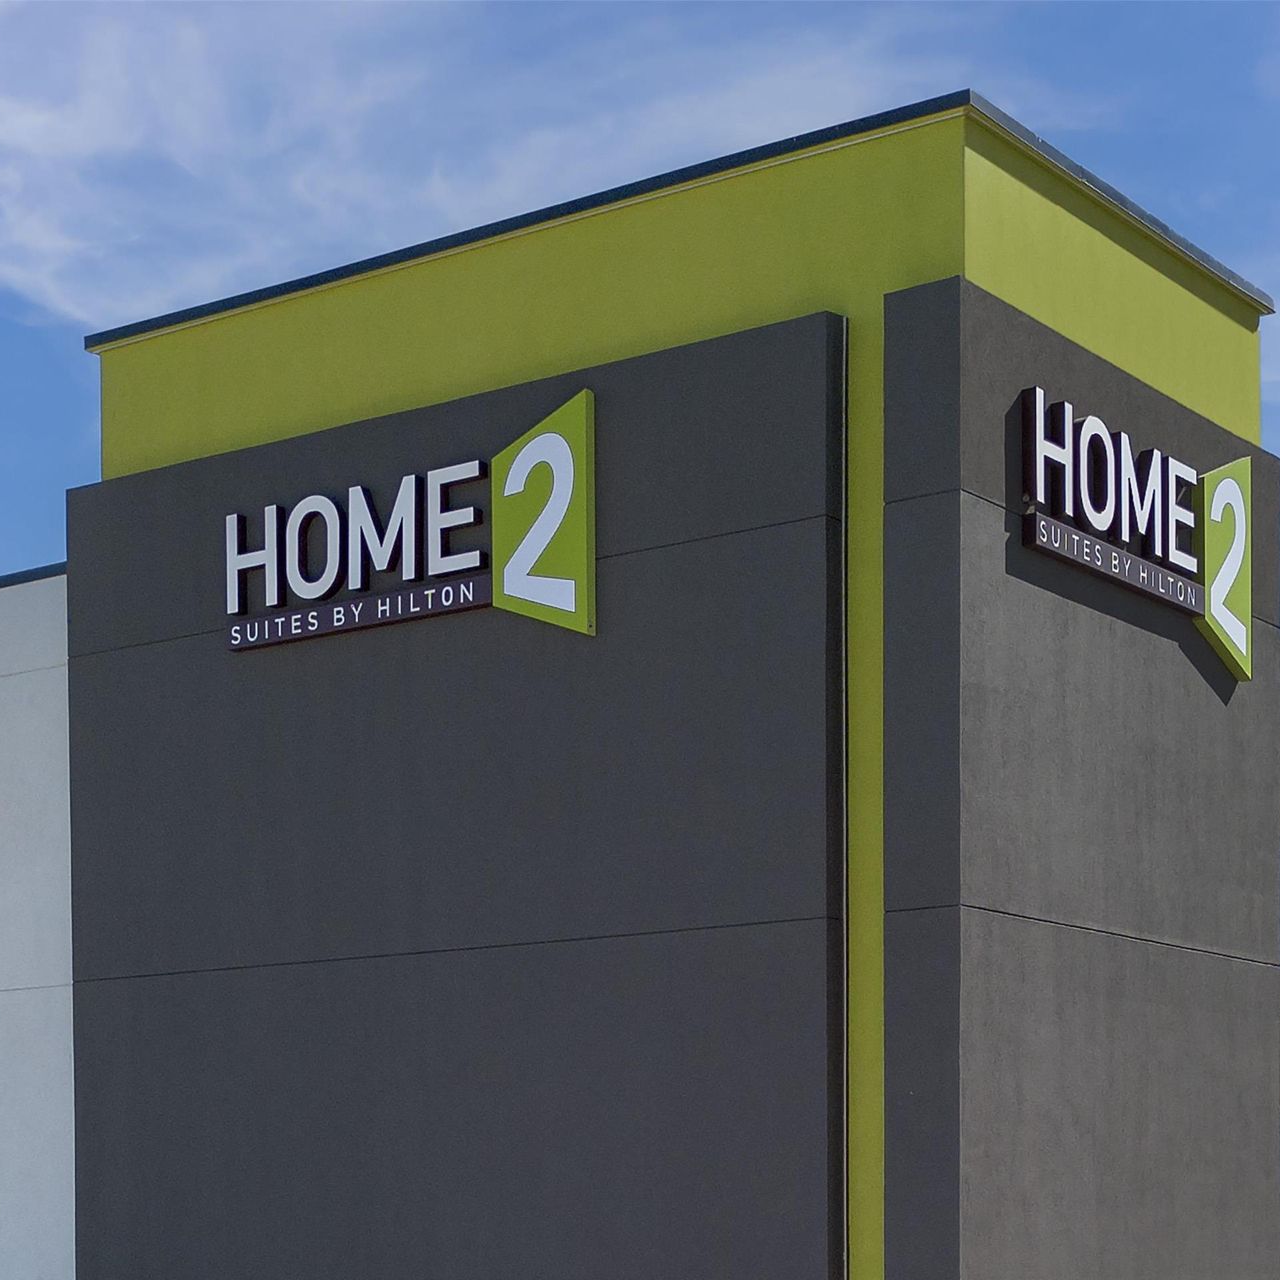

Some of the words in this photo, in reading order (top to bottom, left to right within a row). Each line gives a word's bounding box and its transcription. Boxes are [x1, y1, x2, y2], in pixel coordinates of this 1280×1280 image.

[1039, 520, 1102, 566] SUITES
[1111, 551, 1131, 577] BY
[1139, 565, 1196, 606] HILTON
[231, 611, 319, 645] SUITES
[333, 602, 364, 627] BY
[377, 581, 474, 619] HILTON
